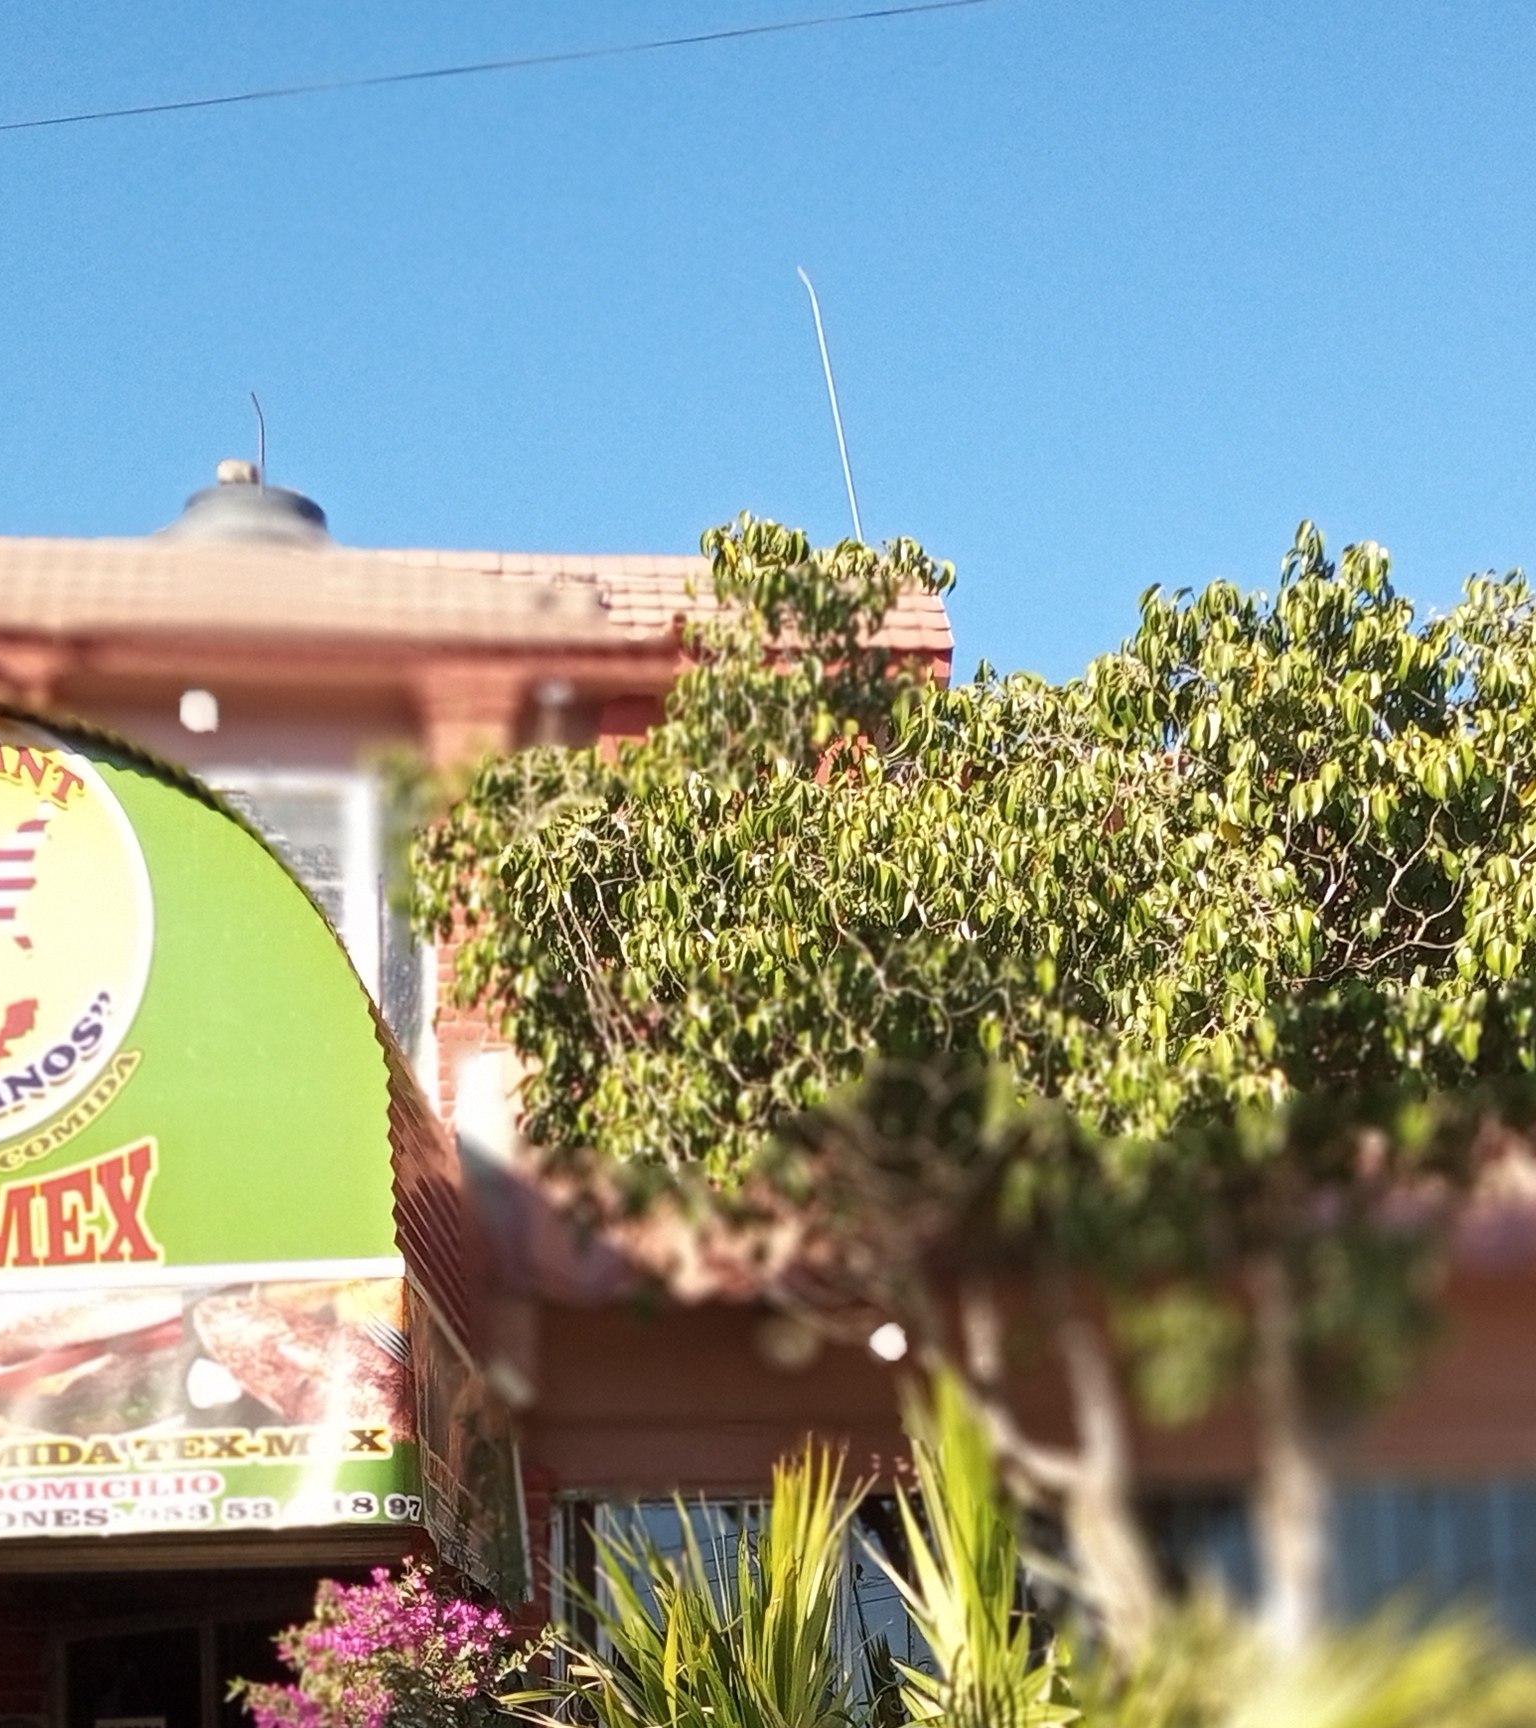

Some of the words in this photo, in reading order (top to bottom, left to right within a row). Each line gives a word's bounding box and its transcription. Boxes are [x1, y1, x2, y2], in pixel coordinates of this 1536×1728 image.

[135, 1428, 388, 1461] TEX-MX
[226, 1502, 273, 1519] 53
[387, 1497, 421, 1519] 97
